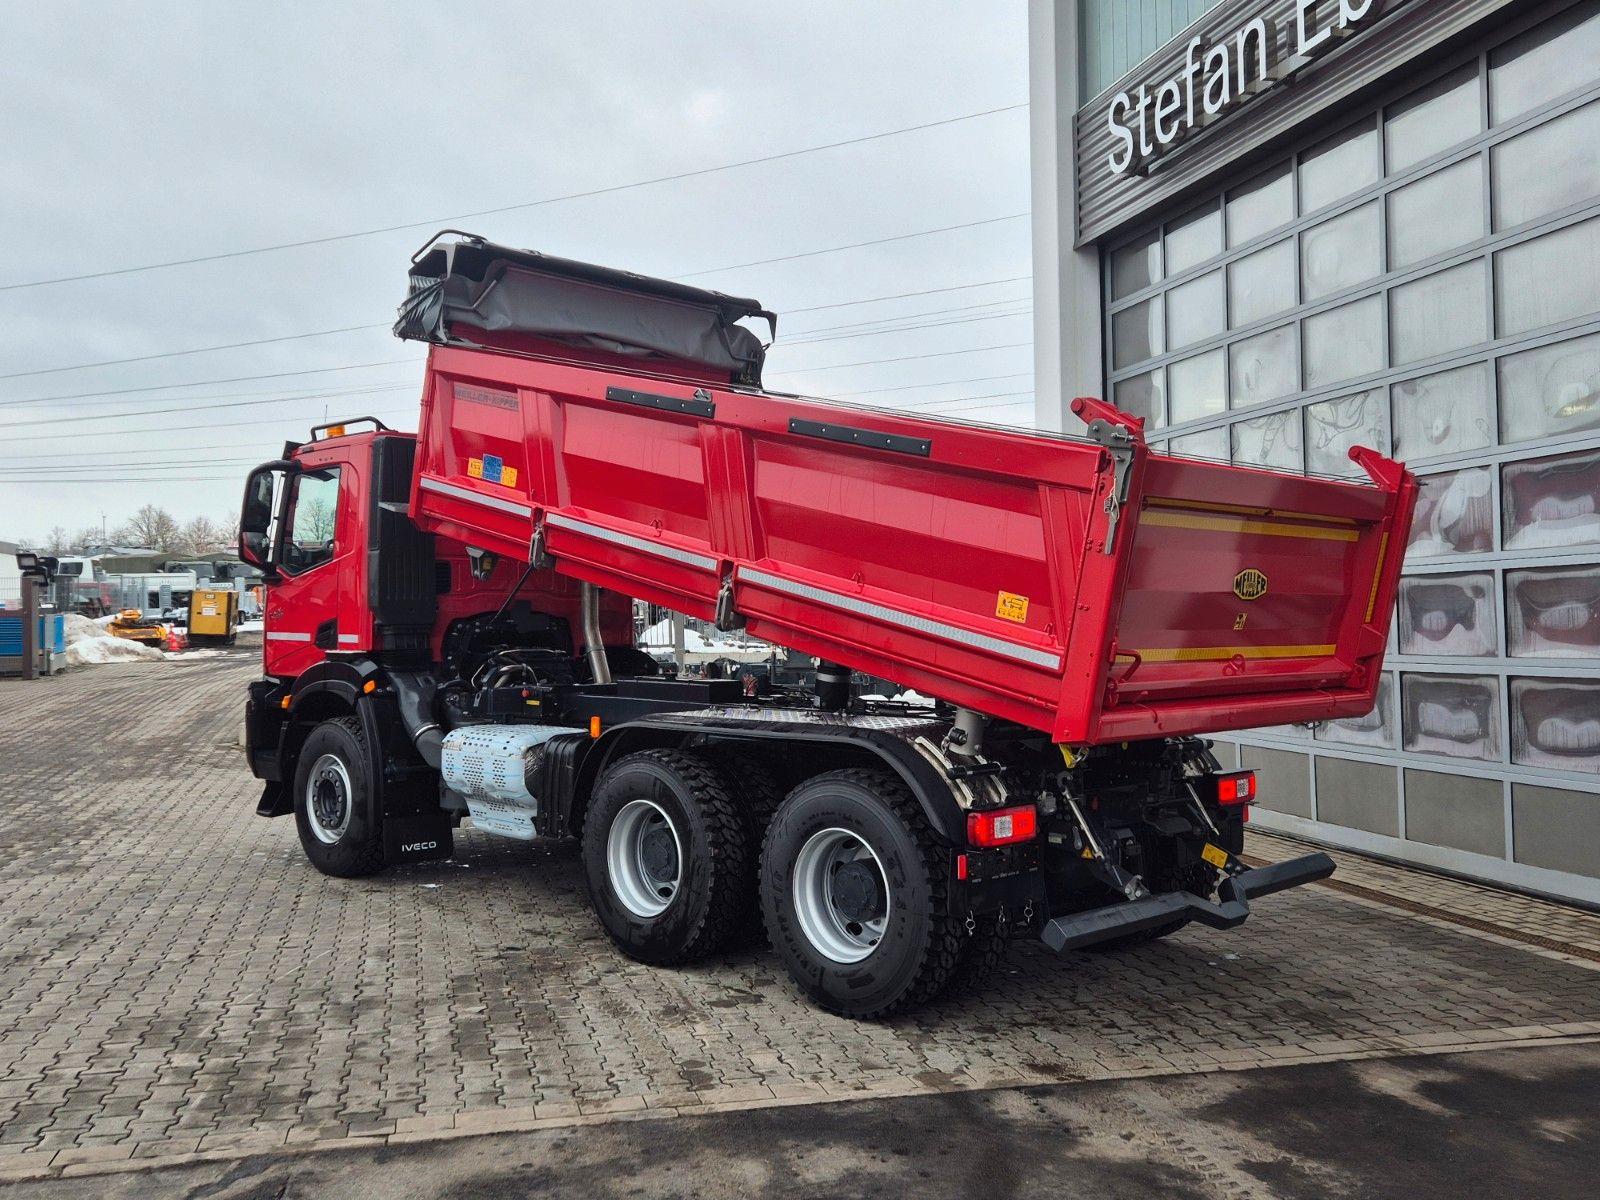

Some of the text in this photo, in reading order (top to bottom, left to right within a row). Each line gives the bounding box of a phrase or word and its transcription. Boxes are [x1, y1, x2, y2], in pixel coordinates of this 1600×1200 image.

[1108, 16, 1267, 175] Stefan
[1235, 571, 1267, 597] MEILLER
[401, 841, 437, 852] IVECO
